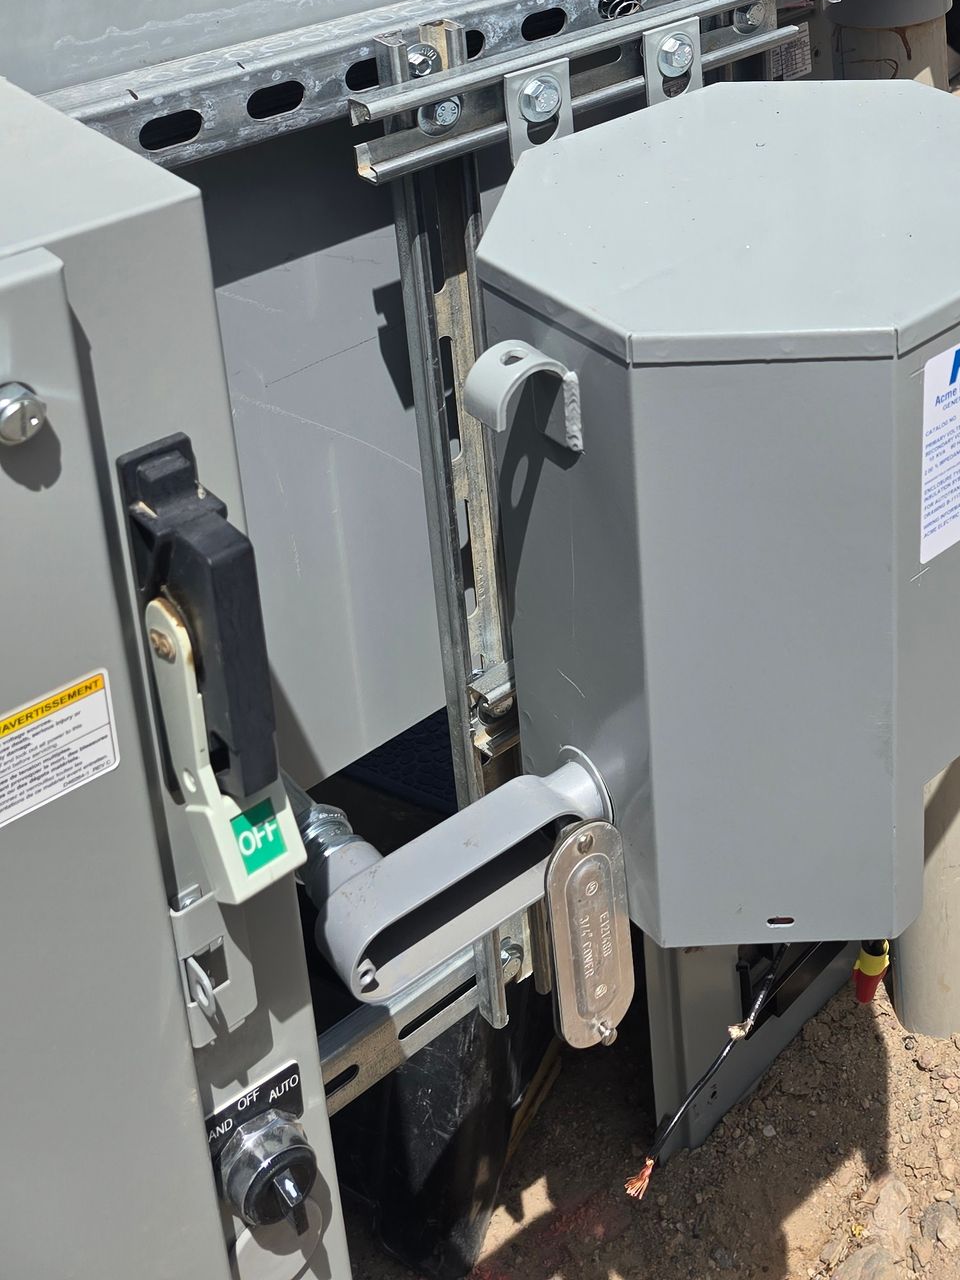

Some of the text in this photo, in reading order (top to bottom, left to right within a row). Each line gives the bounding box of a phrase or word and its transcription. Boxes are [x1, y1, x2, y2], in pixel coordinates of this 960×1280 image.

[935, 387, 956, 406] Acme
[238, 820, 278, 856] OFF
[582, 942, 595, 980] COVER
[236, 1087, 260, 1112] OFF
[268, 1074, 300, 1103] AUTO
[208, 1118, 234, 1142] AND
